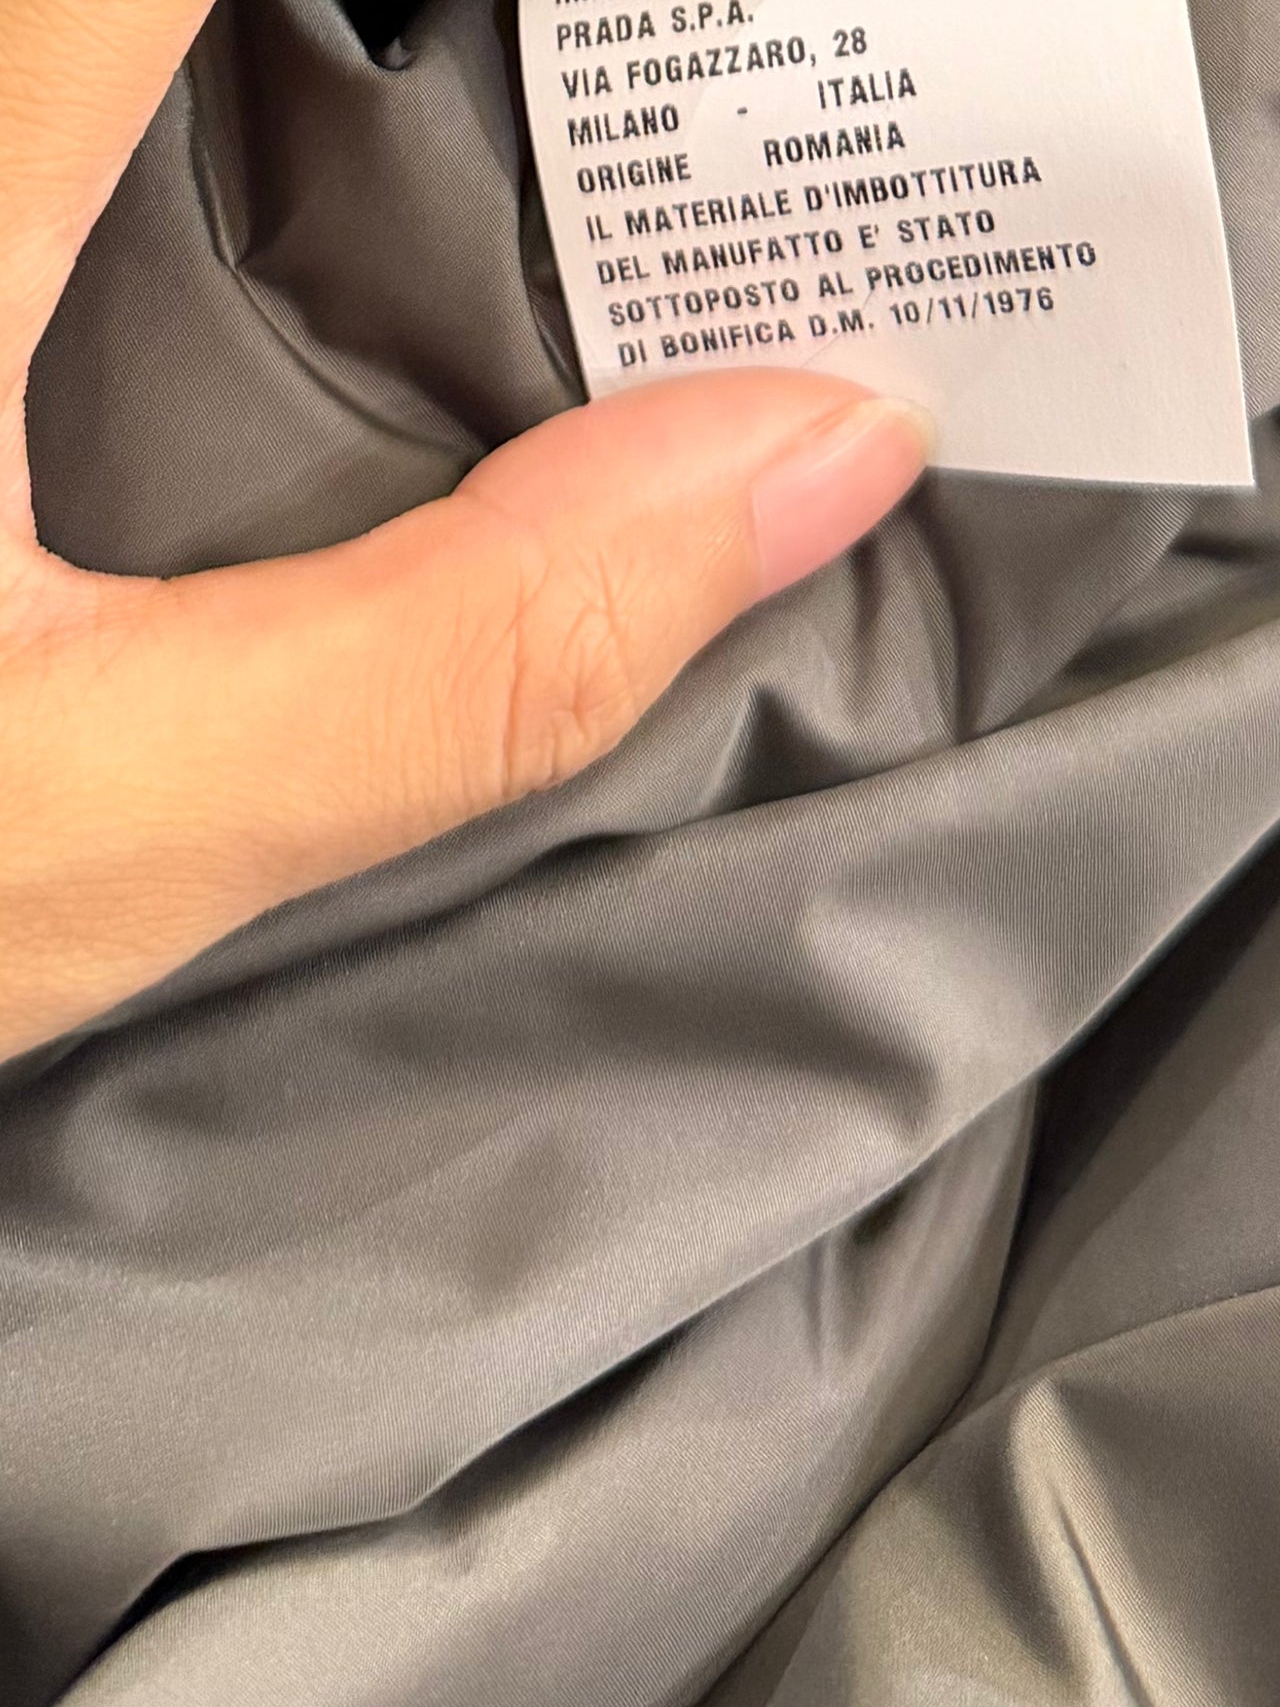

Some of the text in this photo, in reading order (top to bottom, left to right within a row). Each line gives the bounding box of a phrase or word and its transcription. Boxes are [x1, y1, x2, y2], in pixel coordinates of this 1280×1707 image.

[556, 11, 656, 52] PRADA
[561, 27, 867, 99] VIA FOGAZZARO, 28
[567, 68, 917, 147] MILANO ITALIA
[577, 122, 906, 194] ORIGINE ROMANIA
[586, 157, 1042, 242] IL MATERIALE D'IMBOTTITURA
[597, 255, 650, 285] DEL
[662, 230, 843, 276] MANUFATTO
[897, 210, 995, 244] STATO
[608, 242, 1096, 327] SOTTOPOSTO AL PROCEDIMENTO
[618, 287, 1054, 368] DI BONIFICA D.M. 10/11/1976
